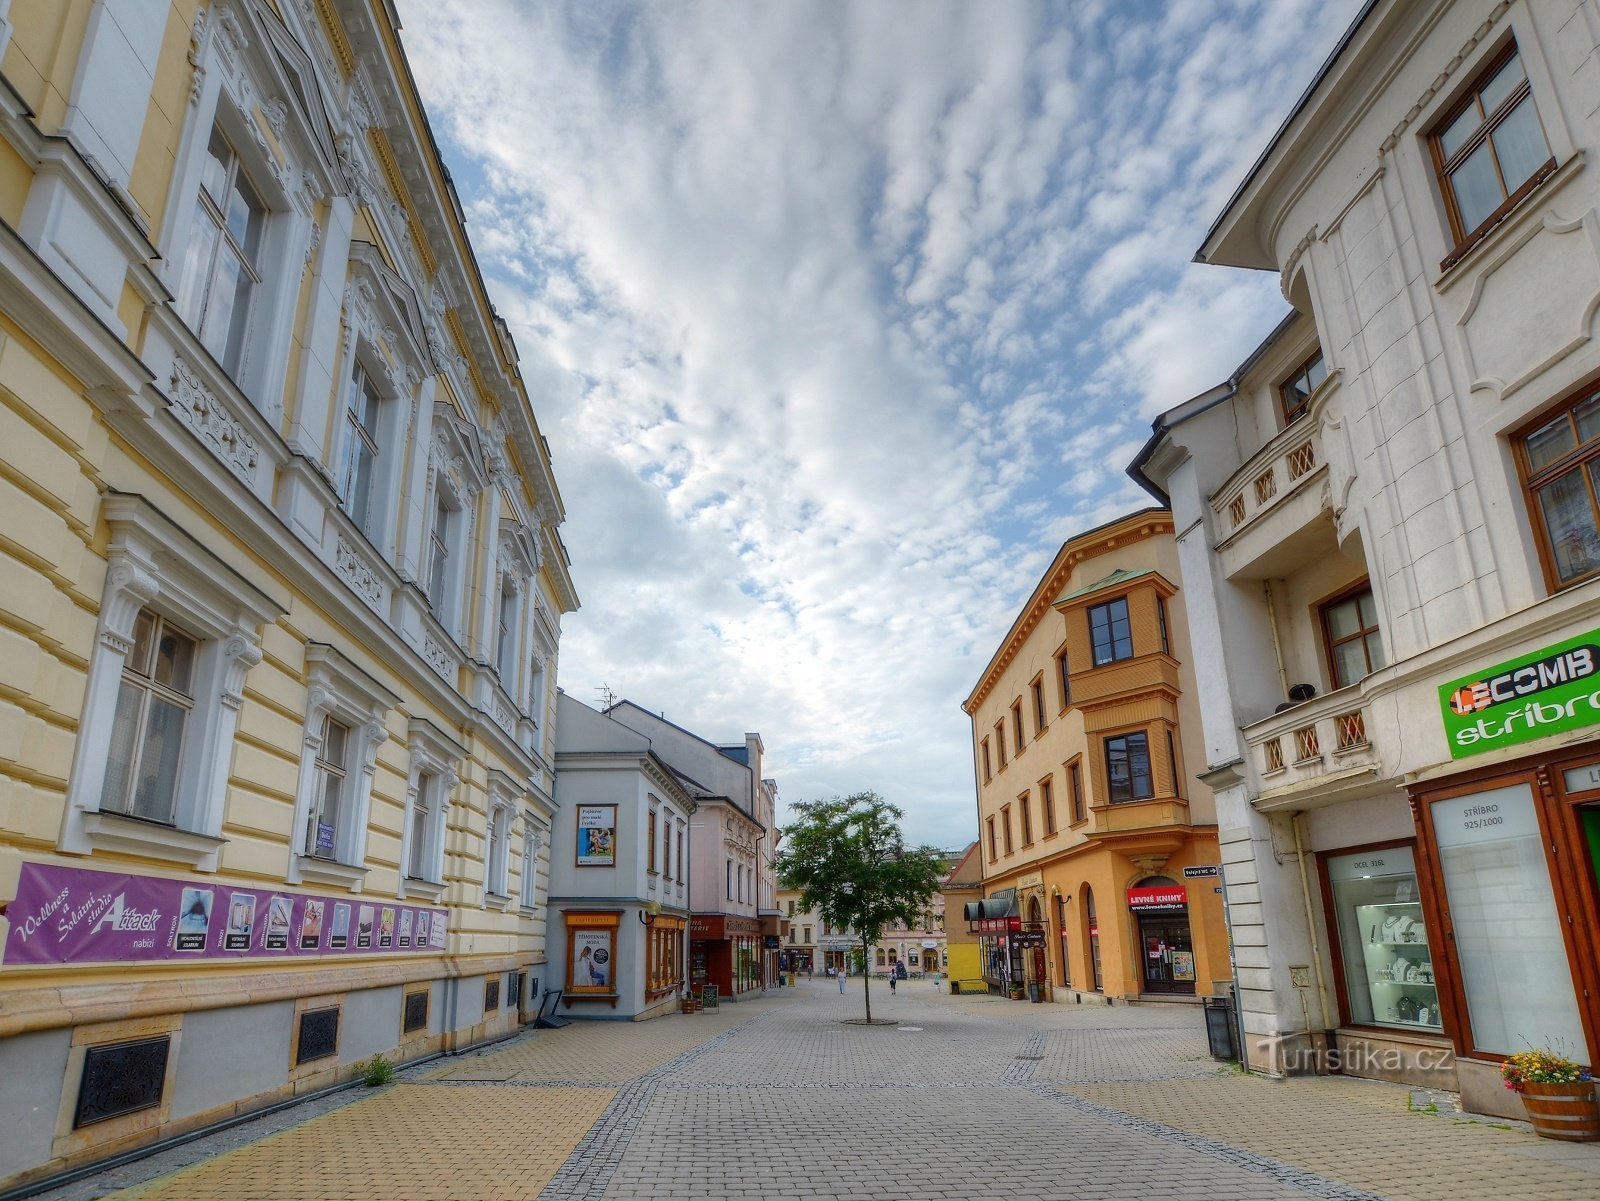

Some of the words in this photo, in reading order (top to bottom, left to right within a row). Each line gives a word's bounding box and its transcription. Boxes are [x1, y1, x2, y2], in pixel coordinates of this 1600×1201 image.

[1454, 648, 1595, 714] LECOMB
[1463, 804, 1499, 818] STŘÍBRO
[1463, 816, 1504, 830] 925/1000
[1353, 860, 1369, 869] OCEL
[1130, 894, 1155, 904] LEVNÉ
[1156, 894, 1182, 903] KNIHY
[14, 886, 70, 943] Wellness
[62, 903, 70, 914] a
[88, 893, 112, 926] studio
[90, 891, 162, 935] Attack
[58, 891, 96, 943] Solární
[133, 938, 155, 948] nabízí
